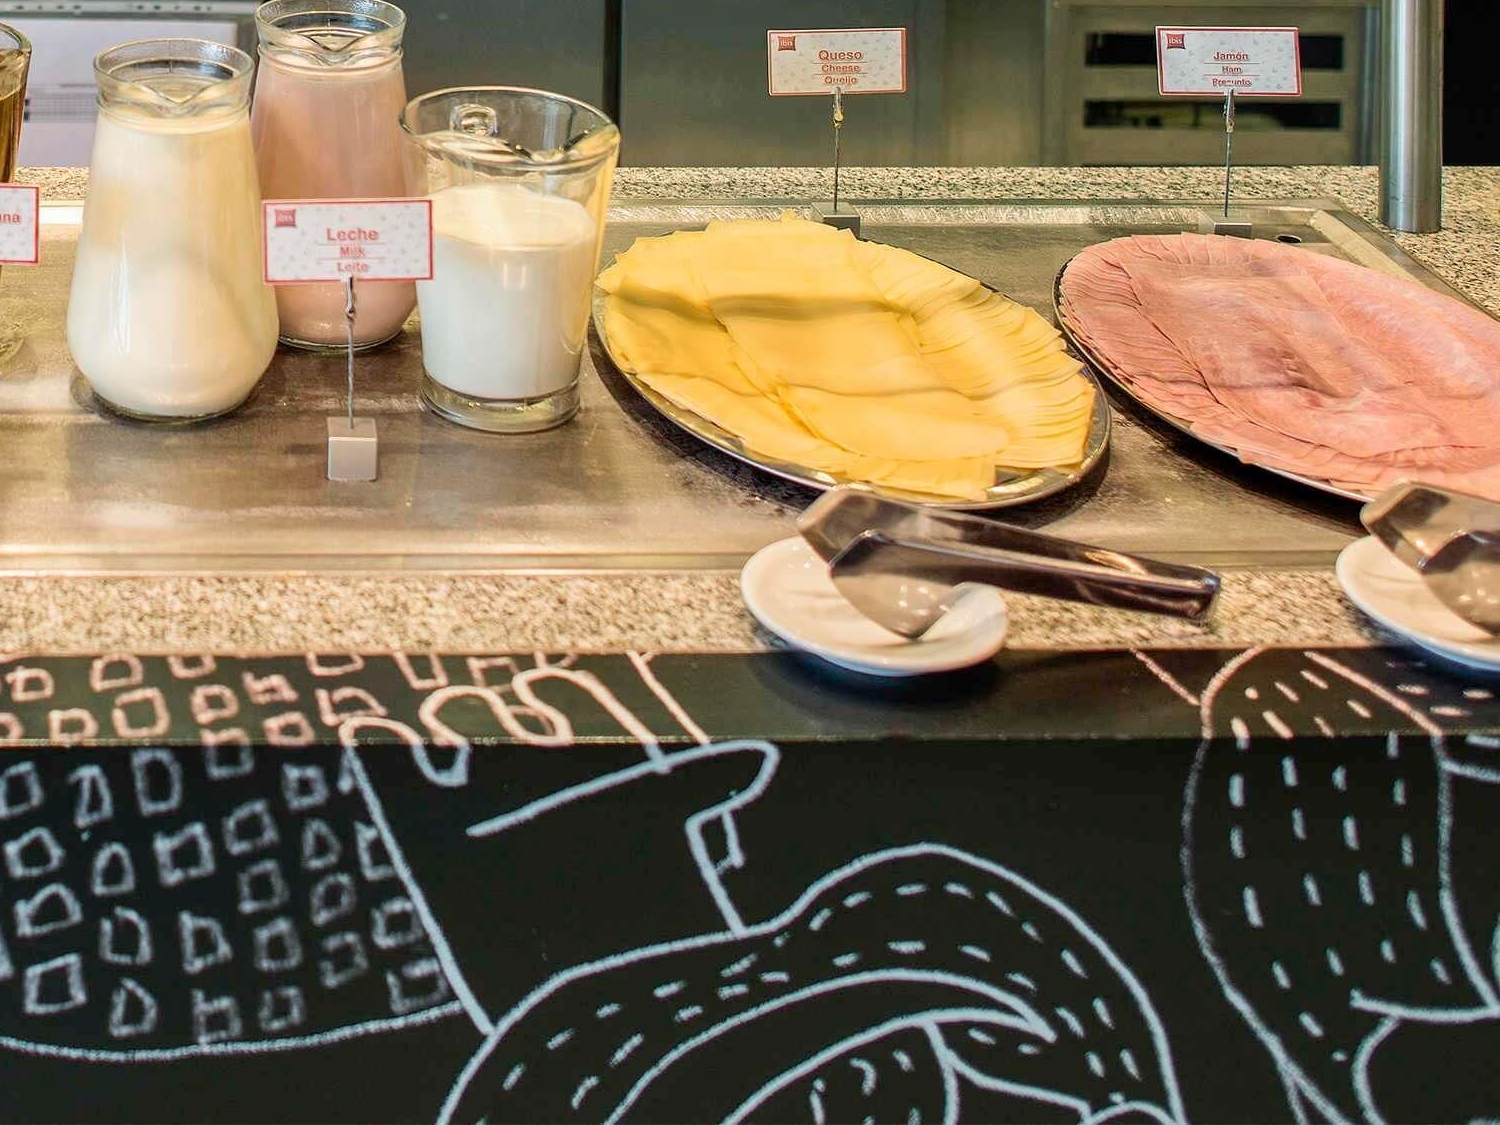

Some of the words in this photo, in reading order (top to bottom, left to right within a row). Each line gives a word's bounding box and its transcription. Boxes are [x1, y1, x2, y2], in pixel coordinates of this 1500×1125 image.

[818, 49, 863, 61] Queso
[1213, 51, 1249, 61] Jamón
[821, 64, 860, 73] Cheese
[1221, 66, 1243, 75] Ham
[824, 76, 858, 85] Queijo
[326, 228, 380, 241] Leche
[340, 246, 365, 257] Milk
[337, 262, 370, 273] Leite
